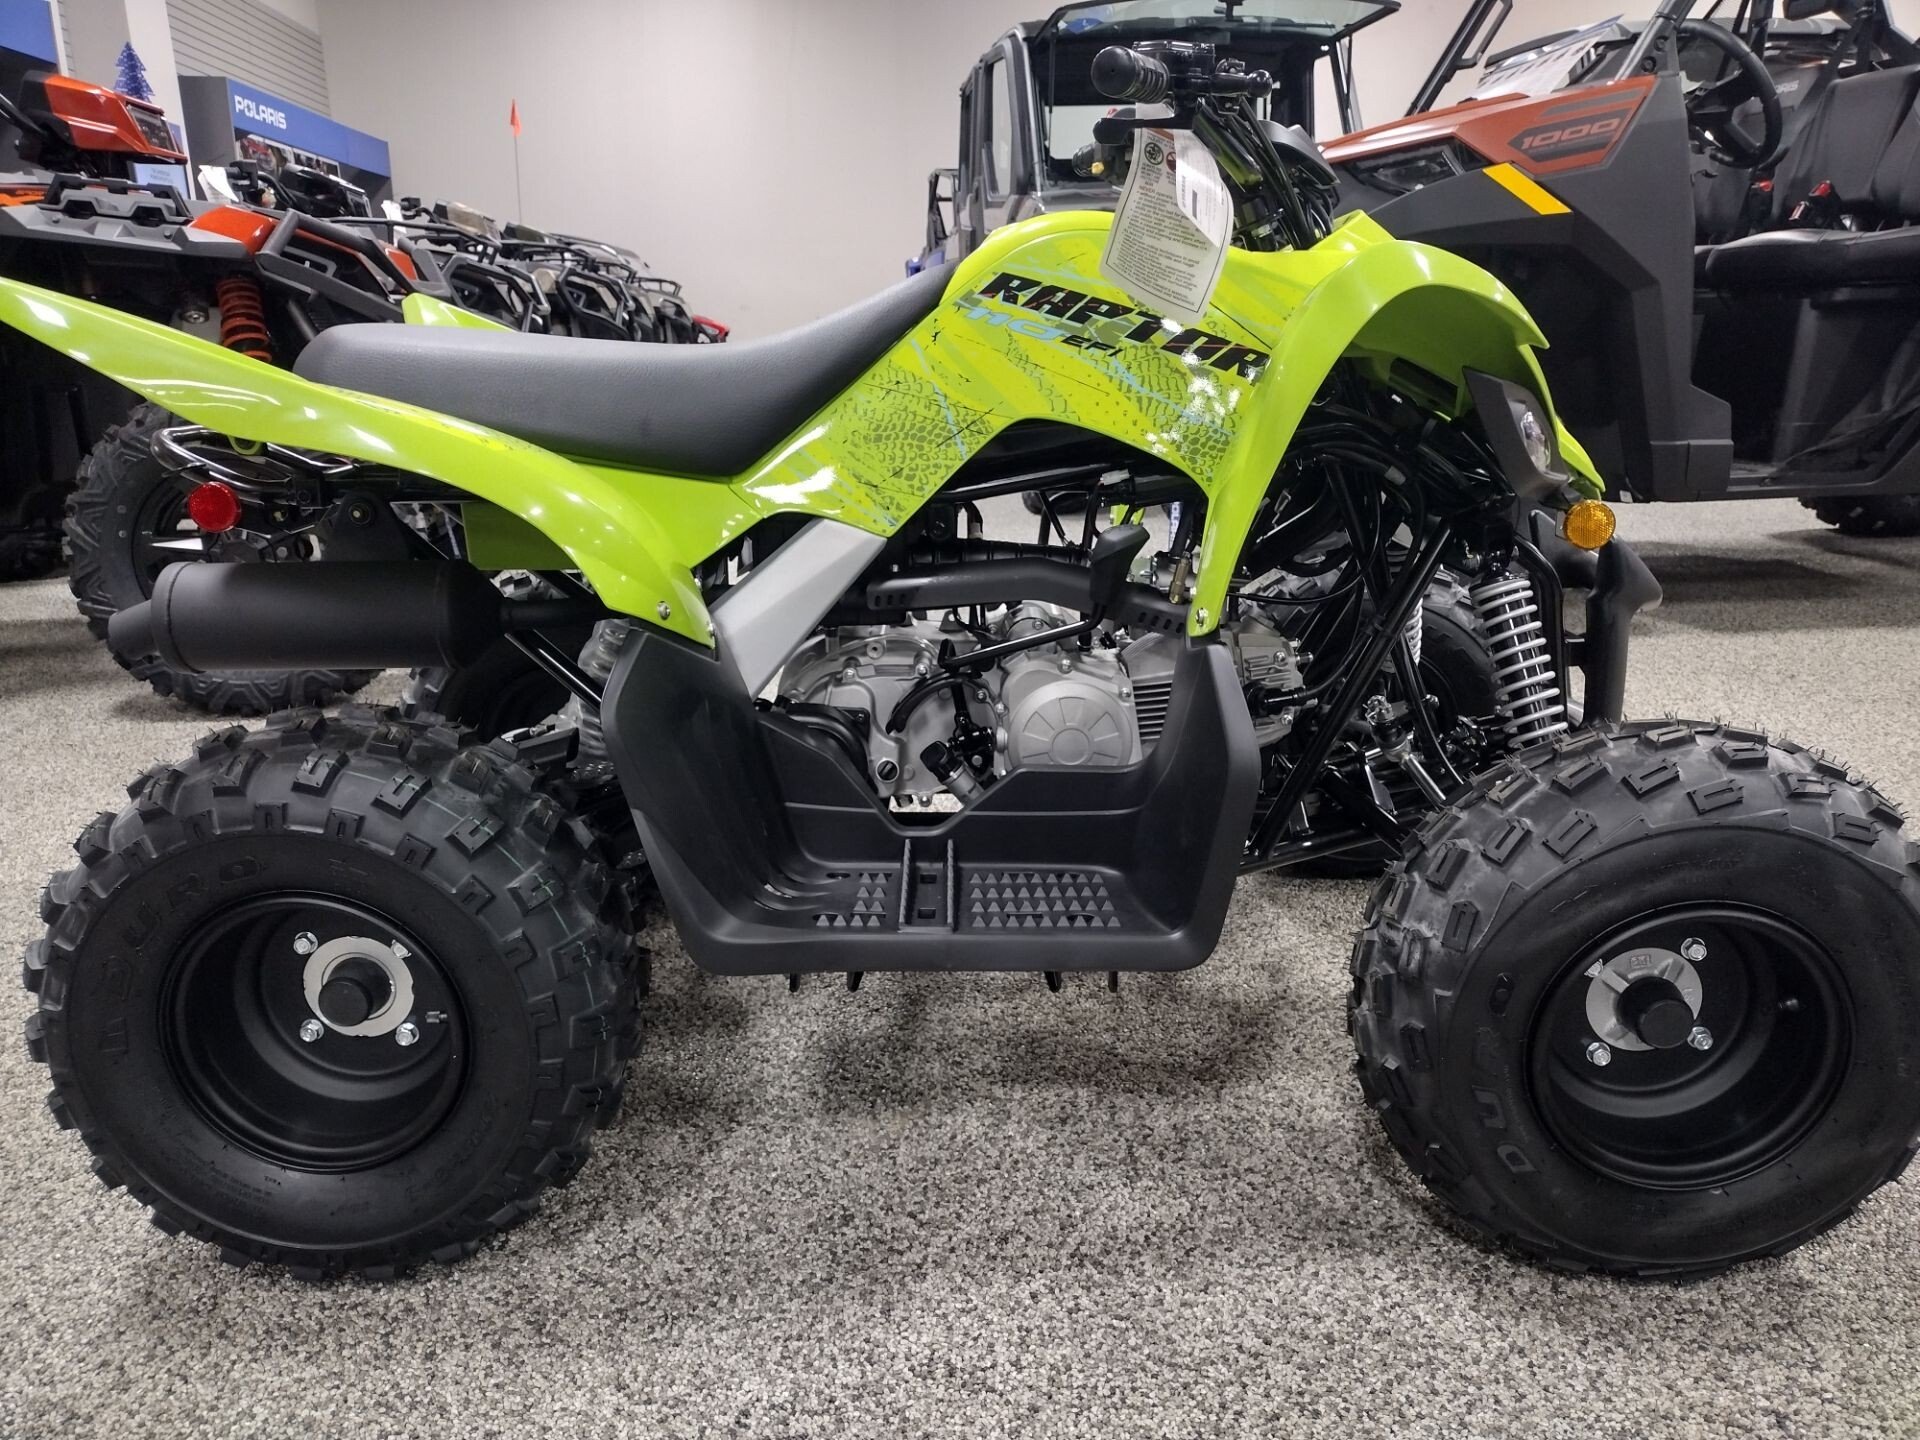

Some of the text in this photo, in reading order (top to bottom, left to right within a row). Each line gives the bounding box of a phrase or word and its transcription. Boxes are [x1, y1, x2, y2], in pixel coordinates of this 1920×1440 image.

[234, 94, 287, 130] POLARIS
[1520, 117, 1621, 150] 1000
[966, 307, 1123, 357] 110 EFI
[977, 272, 1270, 384] RAPTOR
